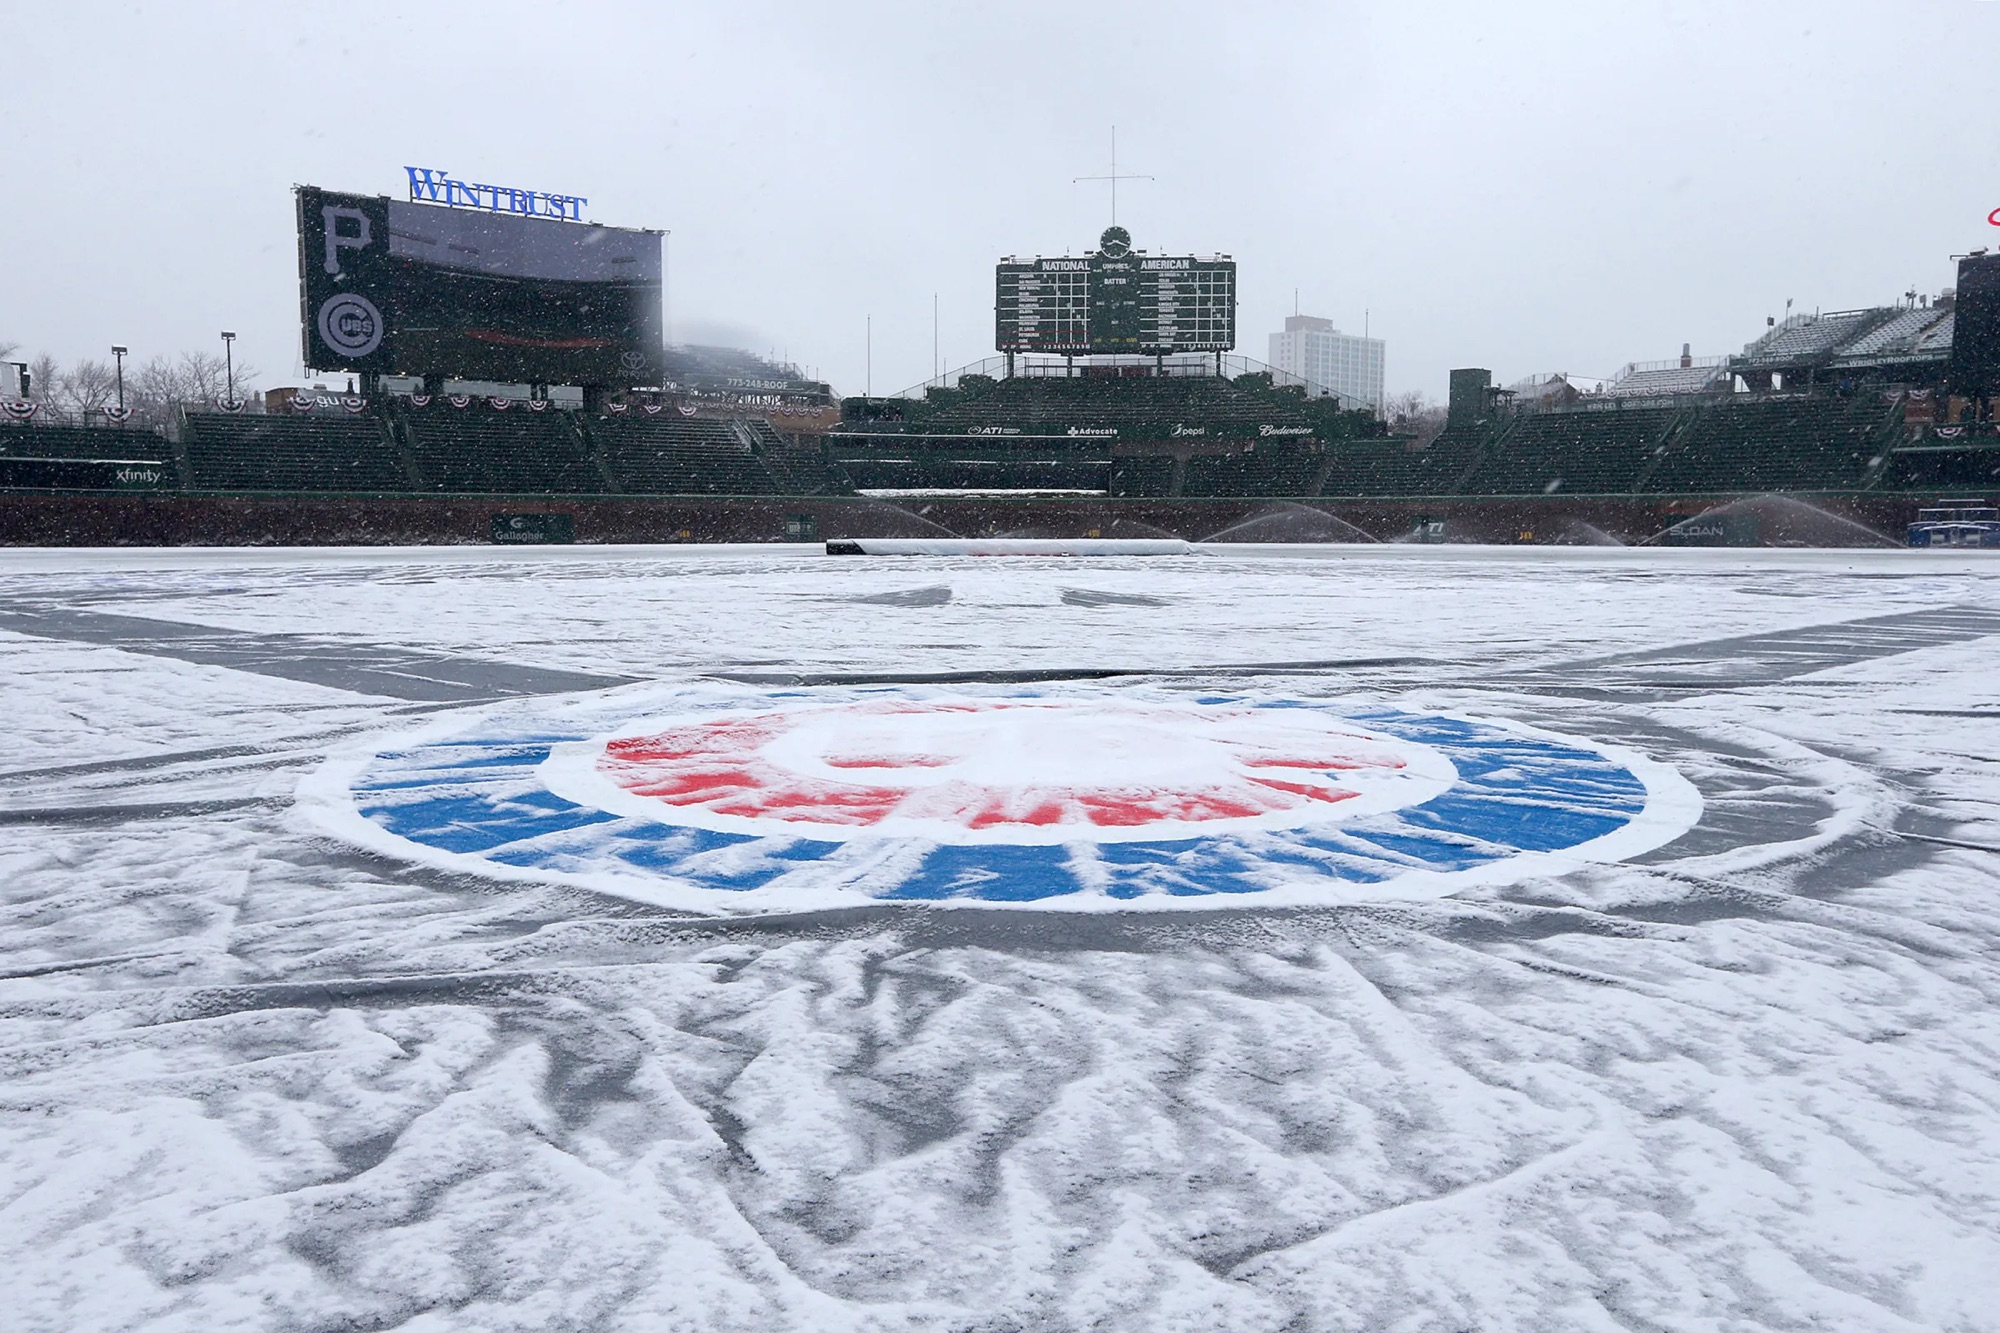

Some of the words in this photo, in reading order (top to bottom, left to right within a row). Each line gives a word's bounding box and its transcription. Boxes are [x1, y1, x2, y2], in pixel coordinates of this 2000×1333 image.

[403, 166, 588, 222] WINTRUST
[321, 205, 372, 274] P
[1042, 261, 1091, 270] NATIONAL
[1140, 260, 1190, 269] AMERICAN
[1182, 427, 1205, 436] pepsi
[1259, 425, 1314, 437] Budweiser
[116, 468, 161, 483] xfinity
[495, 531, 544, 541] Gallagher
[1670, 527, 1724, 536] SLOAN
